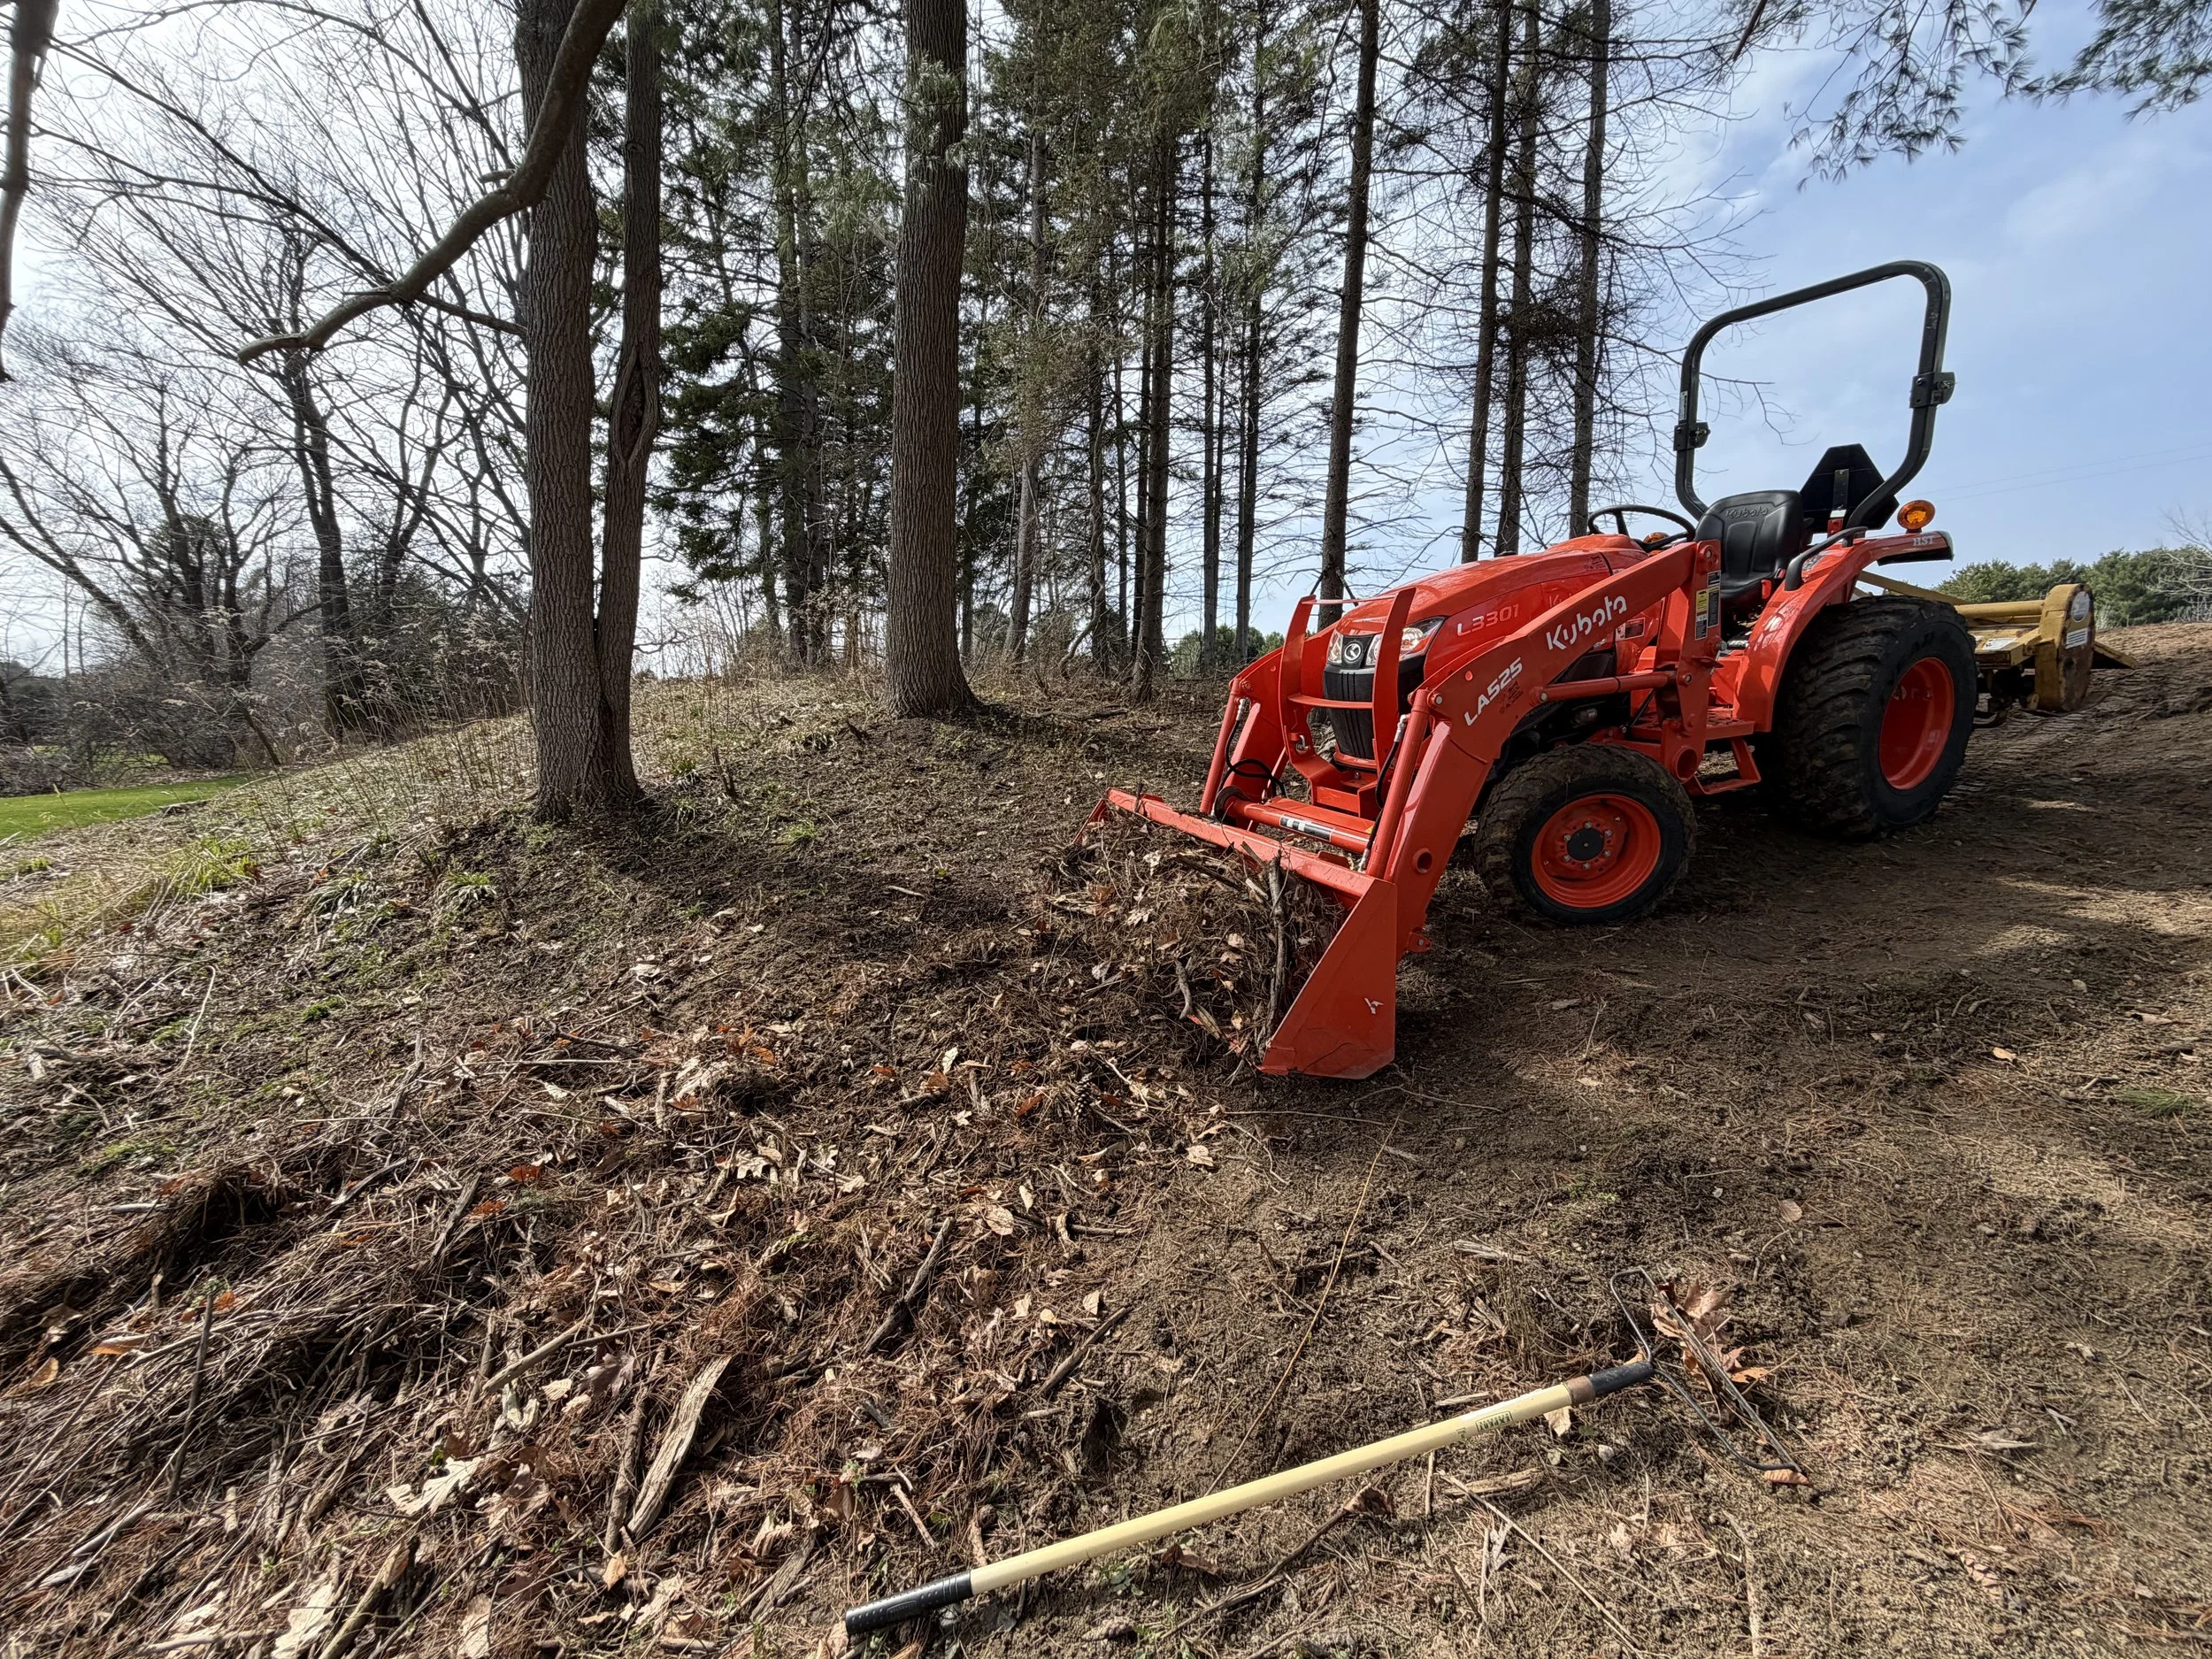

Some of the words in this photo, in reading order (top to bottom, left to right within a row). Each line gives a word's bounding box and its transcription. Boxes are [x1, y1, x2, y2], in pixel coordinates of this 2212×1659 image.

[1726, 506, 1769, 518] Kubota
[1913, 536, 1933, 546] HST
[1457, 603, 1519, 637] L3301
[1546, 595, 1627, 650] Kubota
[1463, 657, 1523, 726] LA525
